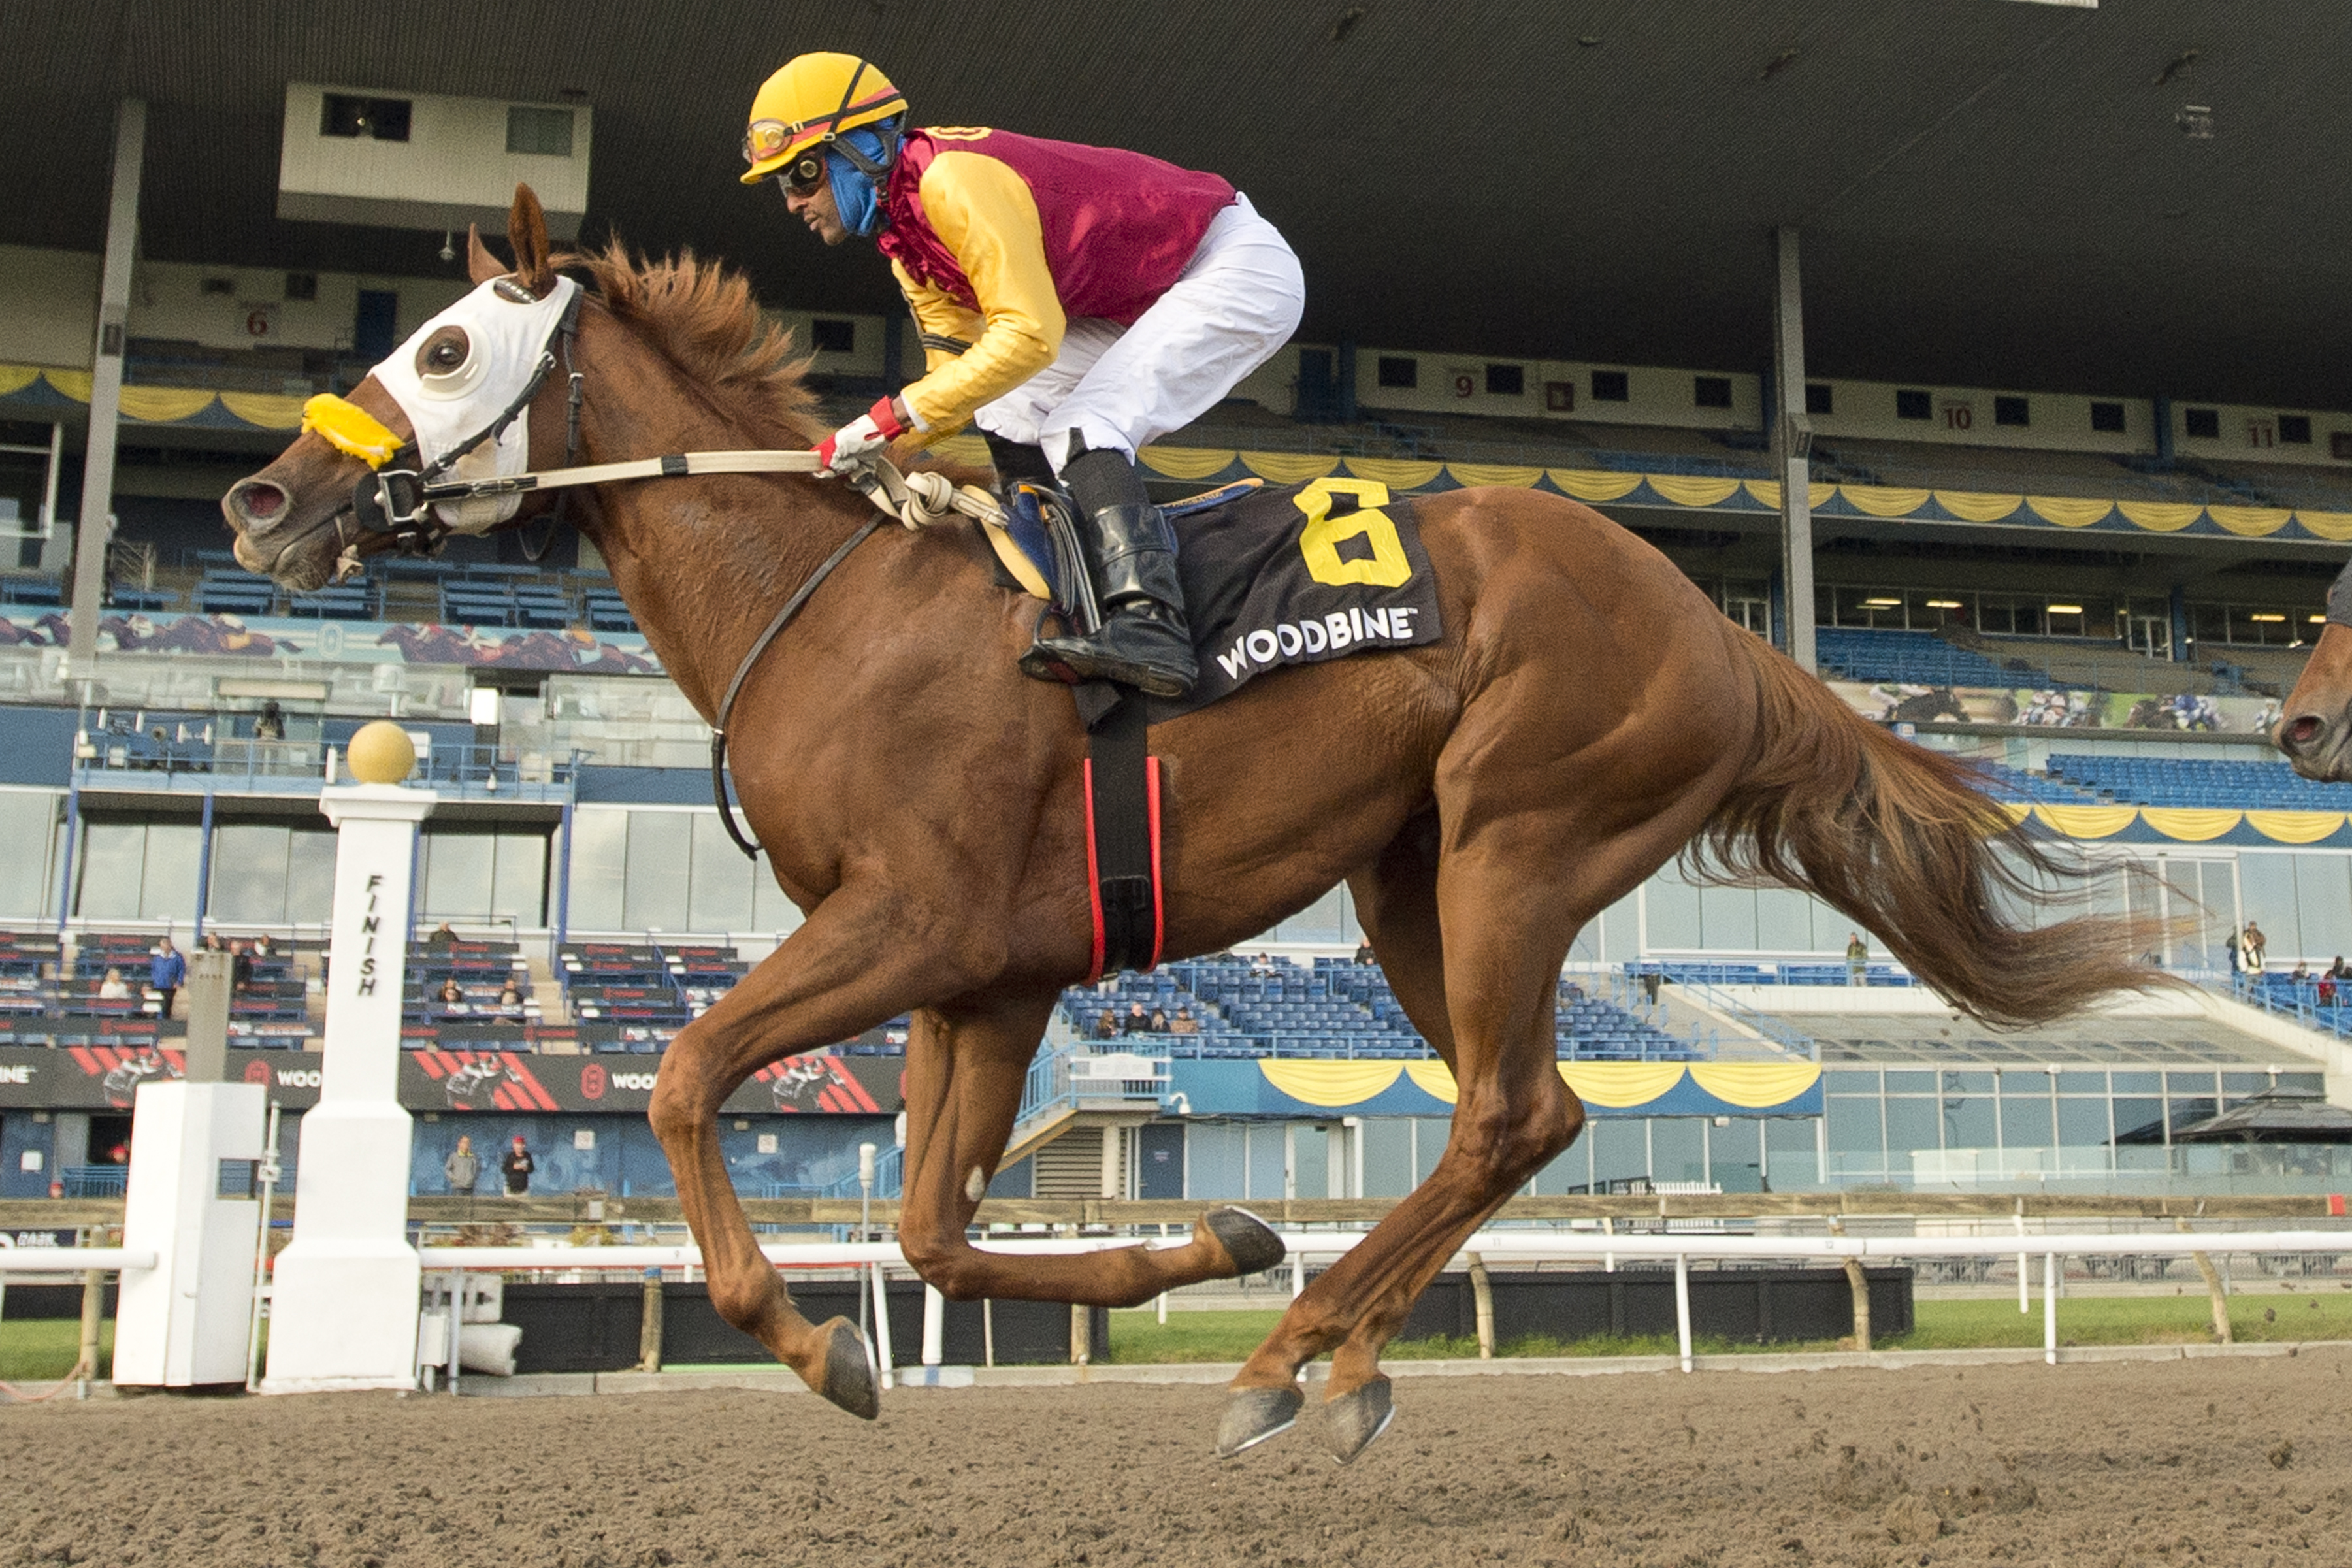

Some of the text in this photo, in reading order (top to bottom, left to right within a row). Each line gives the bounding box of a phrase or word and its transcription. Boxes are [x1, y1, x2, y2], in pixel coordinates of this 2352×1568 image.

[247, 310, 268, 336] 6
[1455, 375, 1474, 398] 9
[1946, 408, 1972, 430] 10
[2249, 426, 2273, 448] 11
[1293, 477, 1413, 587] 6
[357, 874, 384, 997] FINISH
